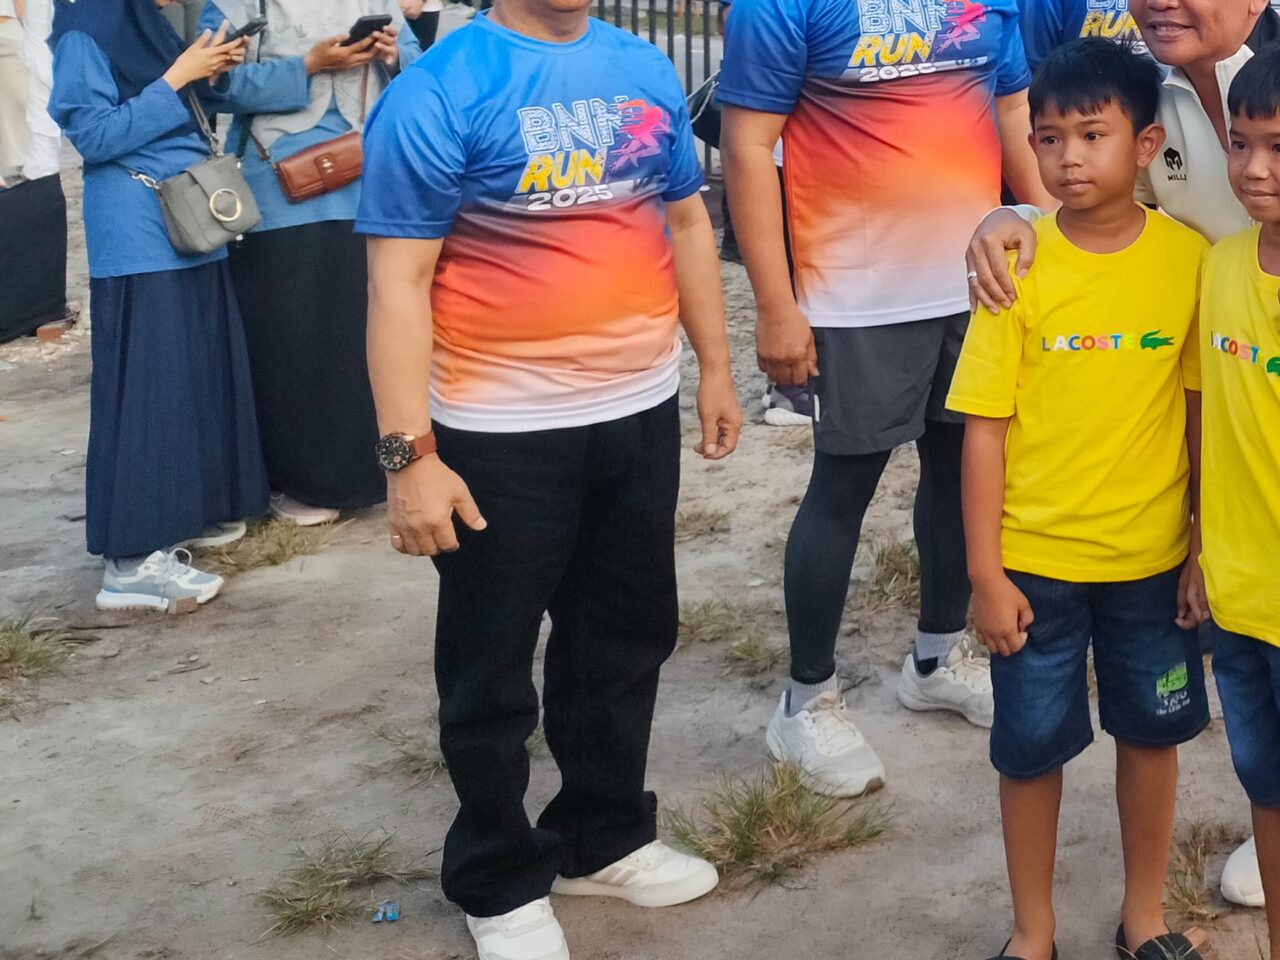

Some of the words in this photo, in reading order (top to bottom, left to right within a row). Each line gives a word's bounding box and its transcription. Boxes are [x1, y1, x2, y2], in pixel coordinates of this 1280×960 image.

[848, 30, 936, 67] RUN
[859, 61, 937, 83] 2025
[515, 146, 607, 194] RUN
[527, 184, 614, 211] 2025
[1042, 335, 1134, 352] LACOSTE
